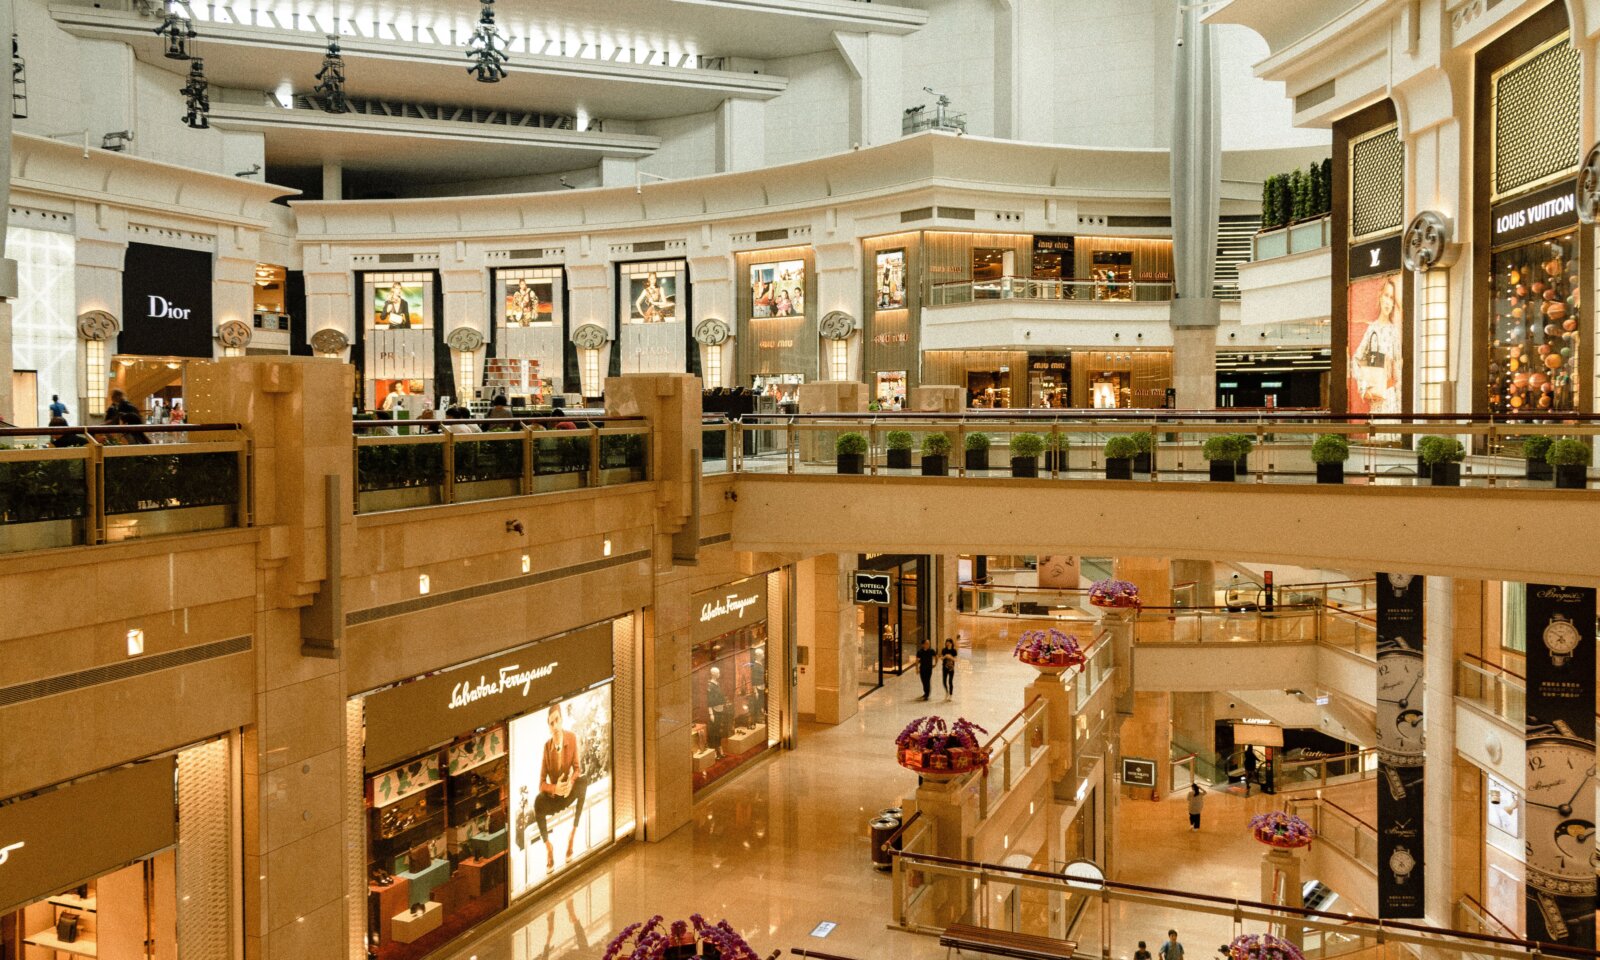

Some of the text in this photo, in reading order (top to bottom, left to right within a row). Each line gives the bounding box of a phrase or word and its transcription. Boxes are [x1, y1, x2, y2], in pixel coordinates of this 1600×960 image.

[1496, 193, 1575, 234] LOUIS VUITTON
[147, 294, 192, 320] Dior
[700, 594, 759, 622] Salvatore Ferragamo
[448, 661, 558, 709] Salvatore Ferragamo
